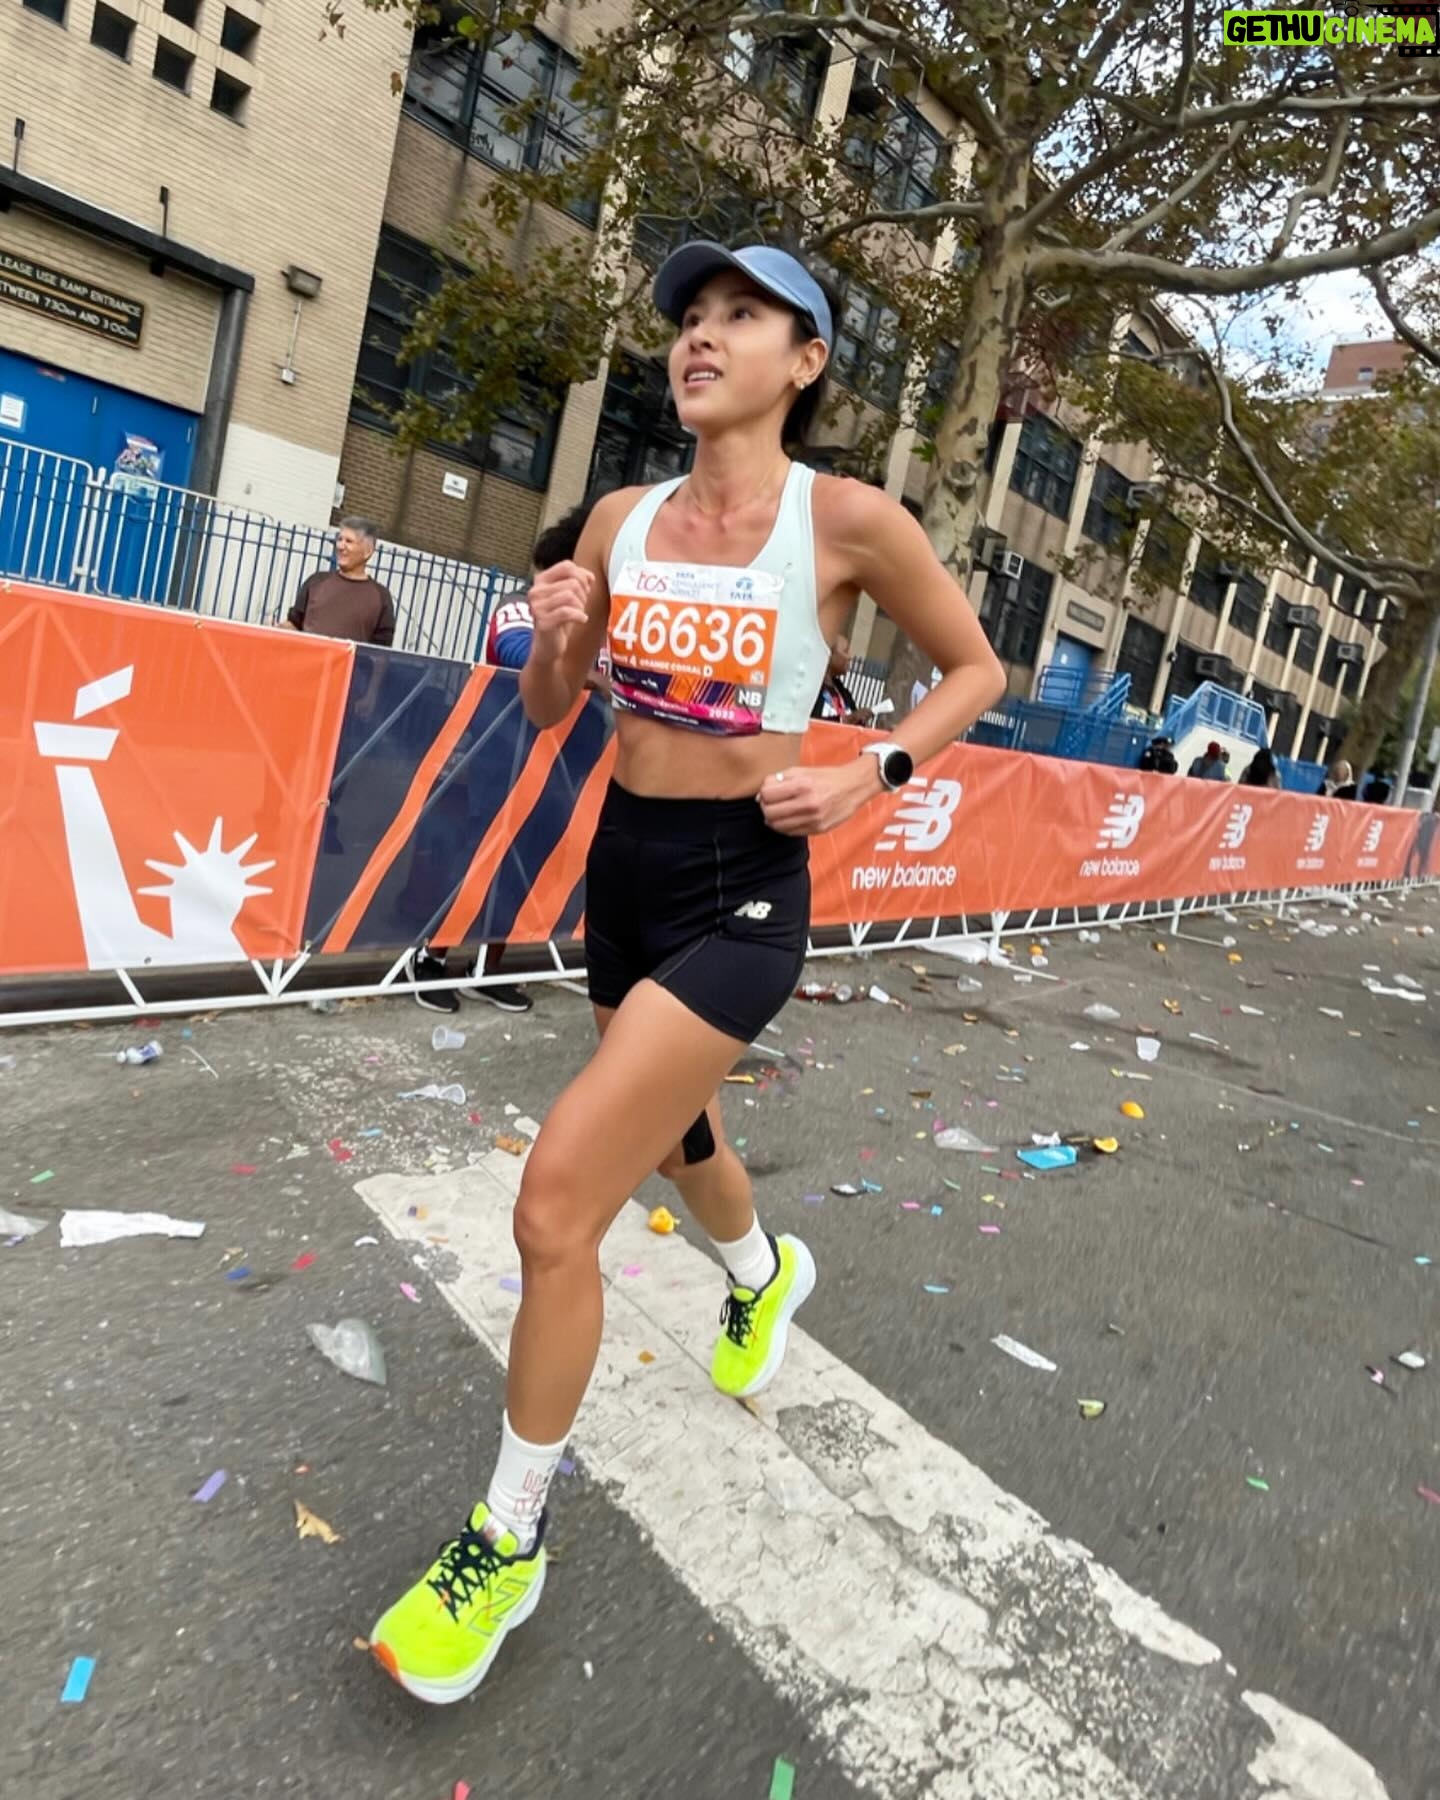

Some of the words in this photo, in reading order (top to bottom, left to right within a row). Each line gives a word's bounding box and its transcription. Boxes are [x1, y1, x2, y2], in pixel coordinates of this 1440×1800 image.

[0, 255, 33, 277] LEASE
[36, 269, 58, 287] USE
[60, 278, 89, 297] RAMP
[90, 289, 141, 317] ENTRANCE
[0, 281, 40, 304] TWEEN
[78, 309, 101, 326] AND
[730, 591, 753, 601] TATA
[612, 601, 767, 666] 46636
[703, 665, 713, 678] D
[738, 689, 762, 707] NB
[851, 865, 892, 890] new
[892, 860, 957, 888] balance
[1080, 859, 1102, 877] new
[1100, 857, 1140, 876] balance
[734, 901, 772, 919] NB
